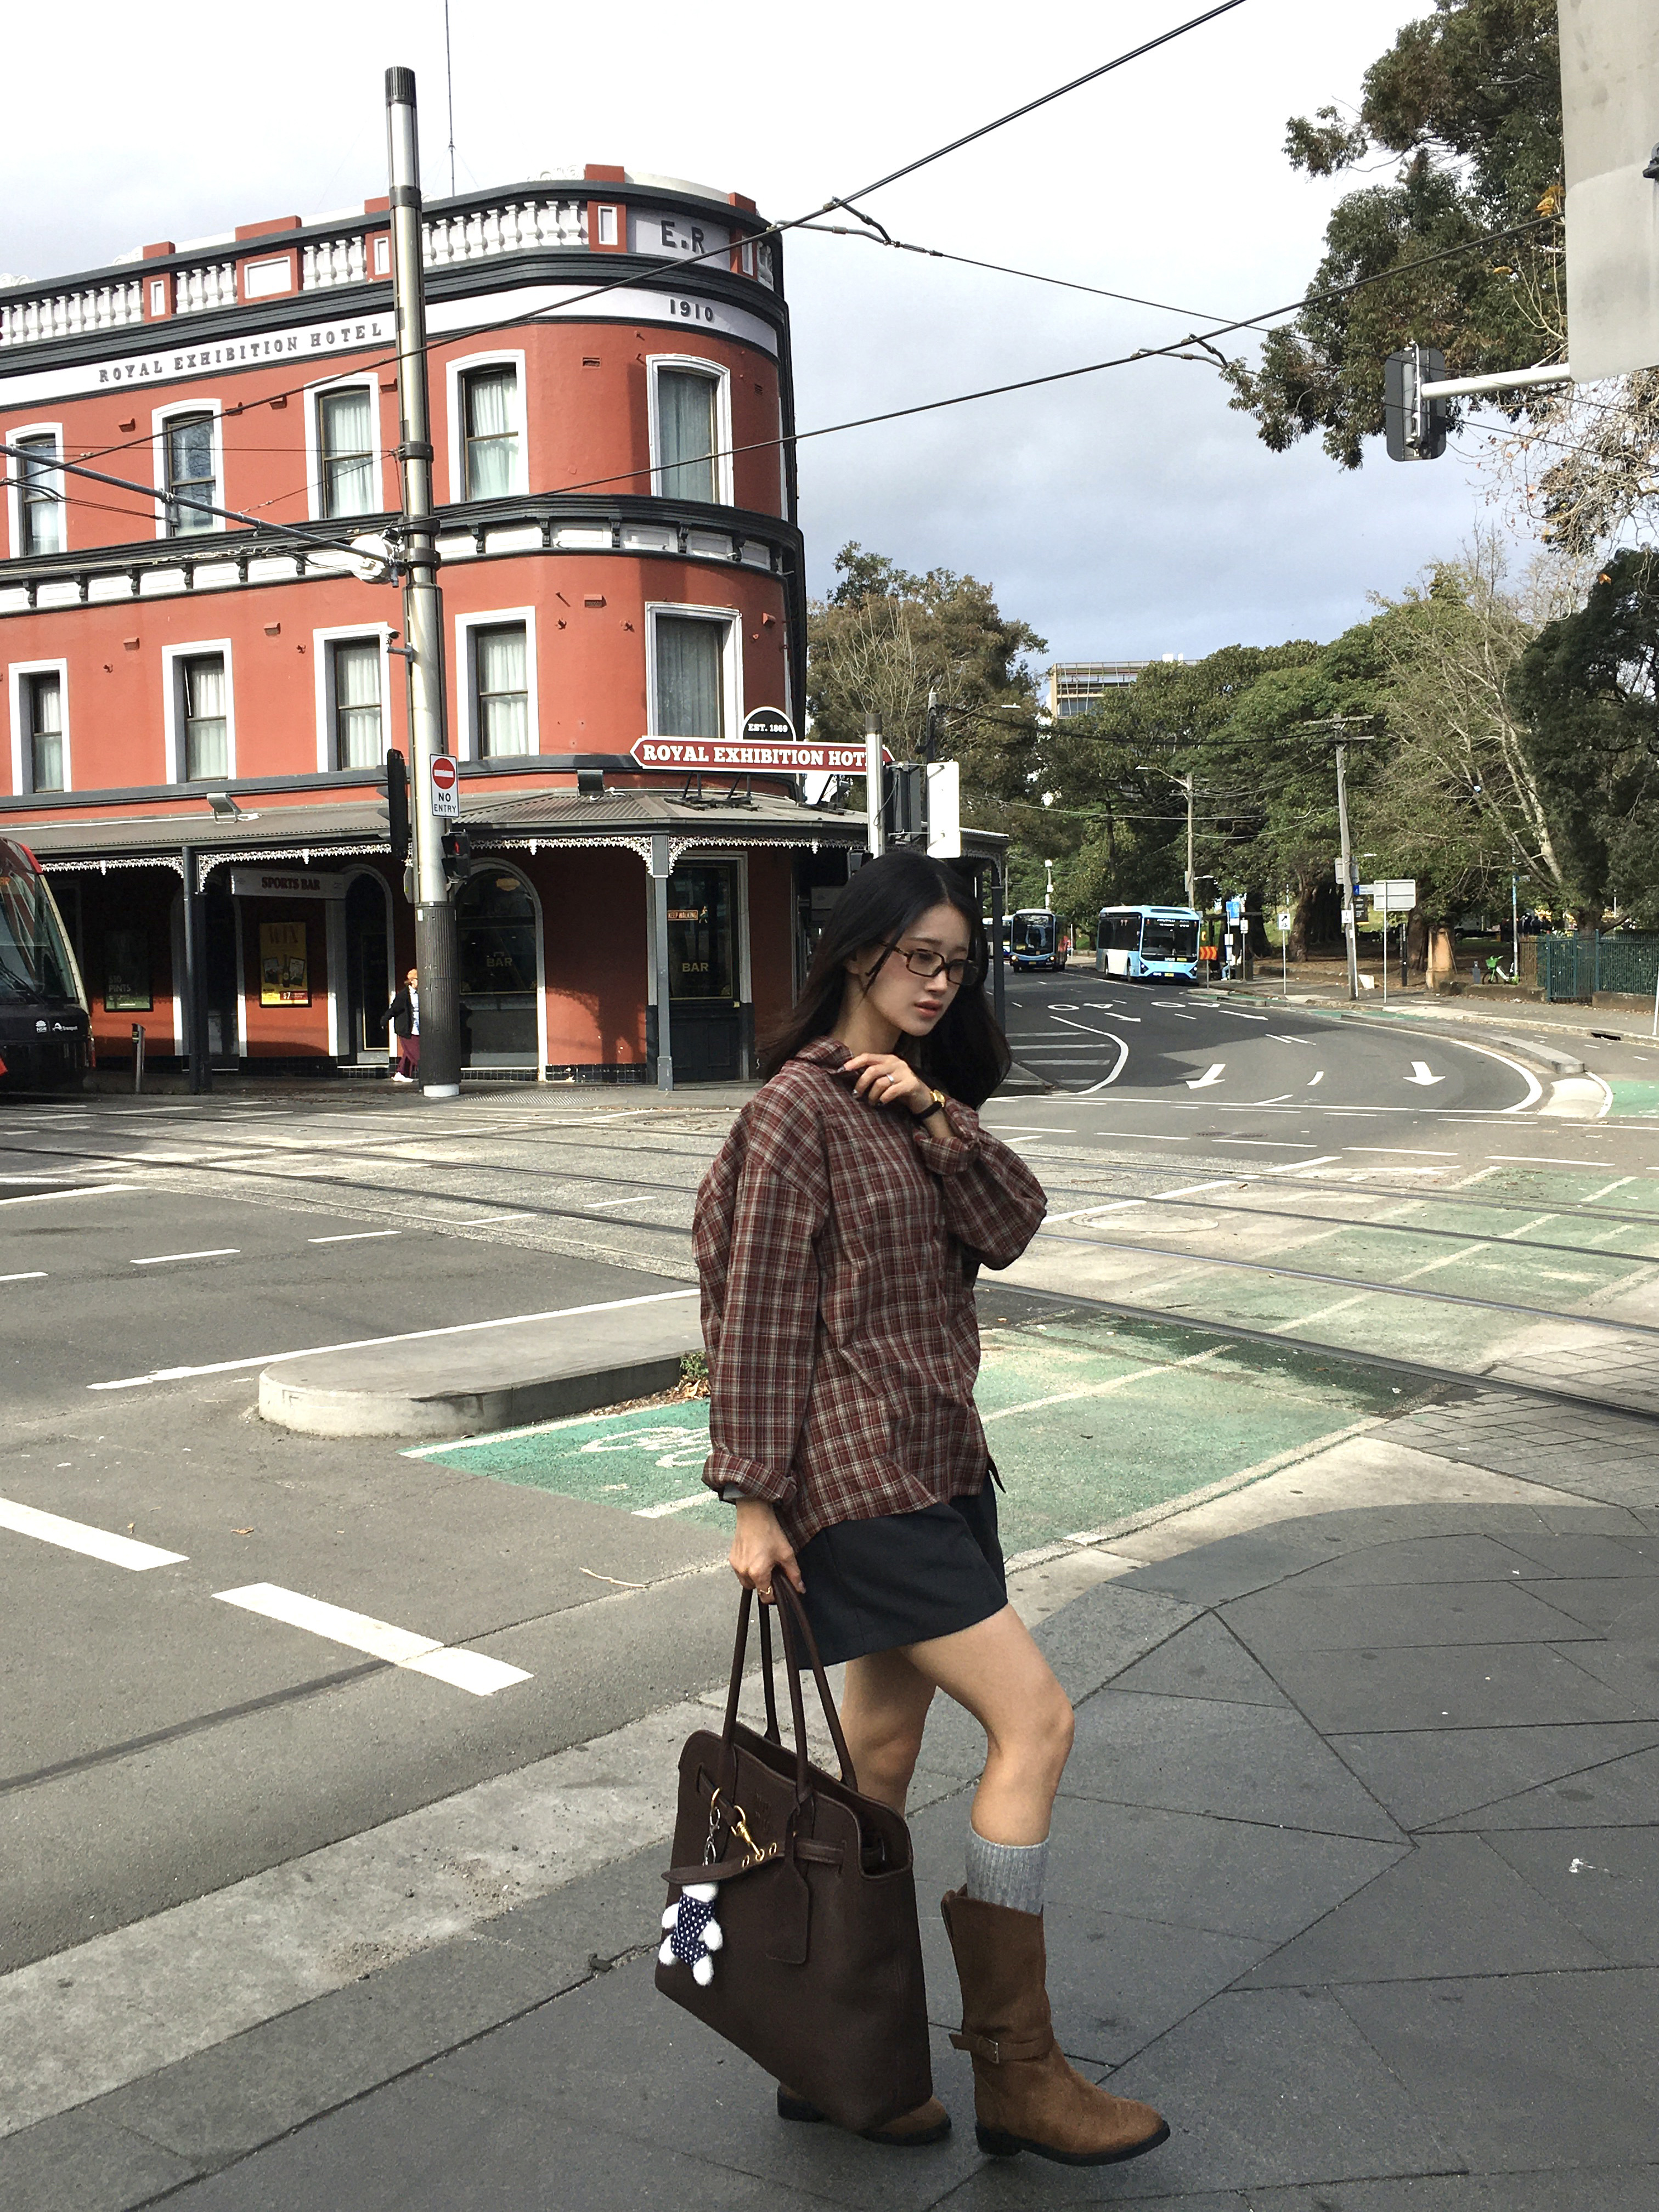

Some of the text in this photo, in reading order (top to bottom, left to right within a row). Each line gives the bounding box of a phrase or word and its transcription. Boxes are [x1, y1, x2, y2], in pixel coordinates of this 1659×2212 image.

[670, 299, 714, 321] 1910
[99, 323, 382, 383] ROYAL EXHIBITION HOTEL
[748, 723, 788, 733] EST. 1869
[643, 744, 885, 766] ROYAL EXHIBITION HOT
[438, 792, 451, 802] NO
[434, 804, 456, 813] ENTRY
[261, 877, 300, 889] SPORTS
[301, 878, 321, 891] BAR
[487, 957, 513, 967] BAR
[682, 963, 709, 973] BAR
[109, 984, 131, 992] PINTS
